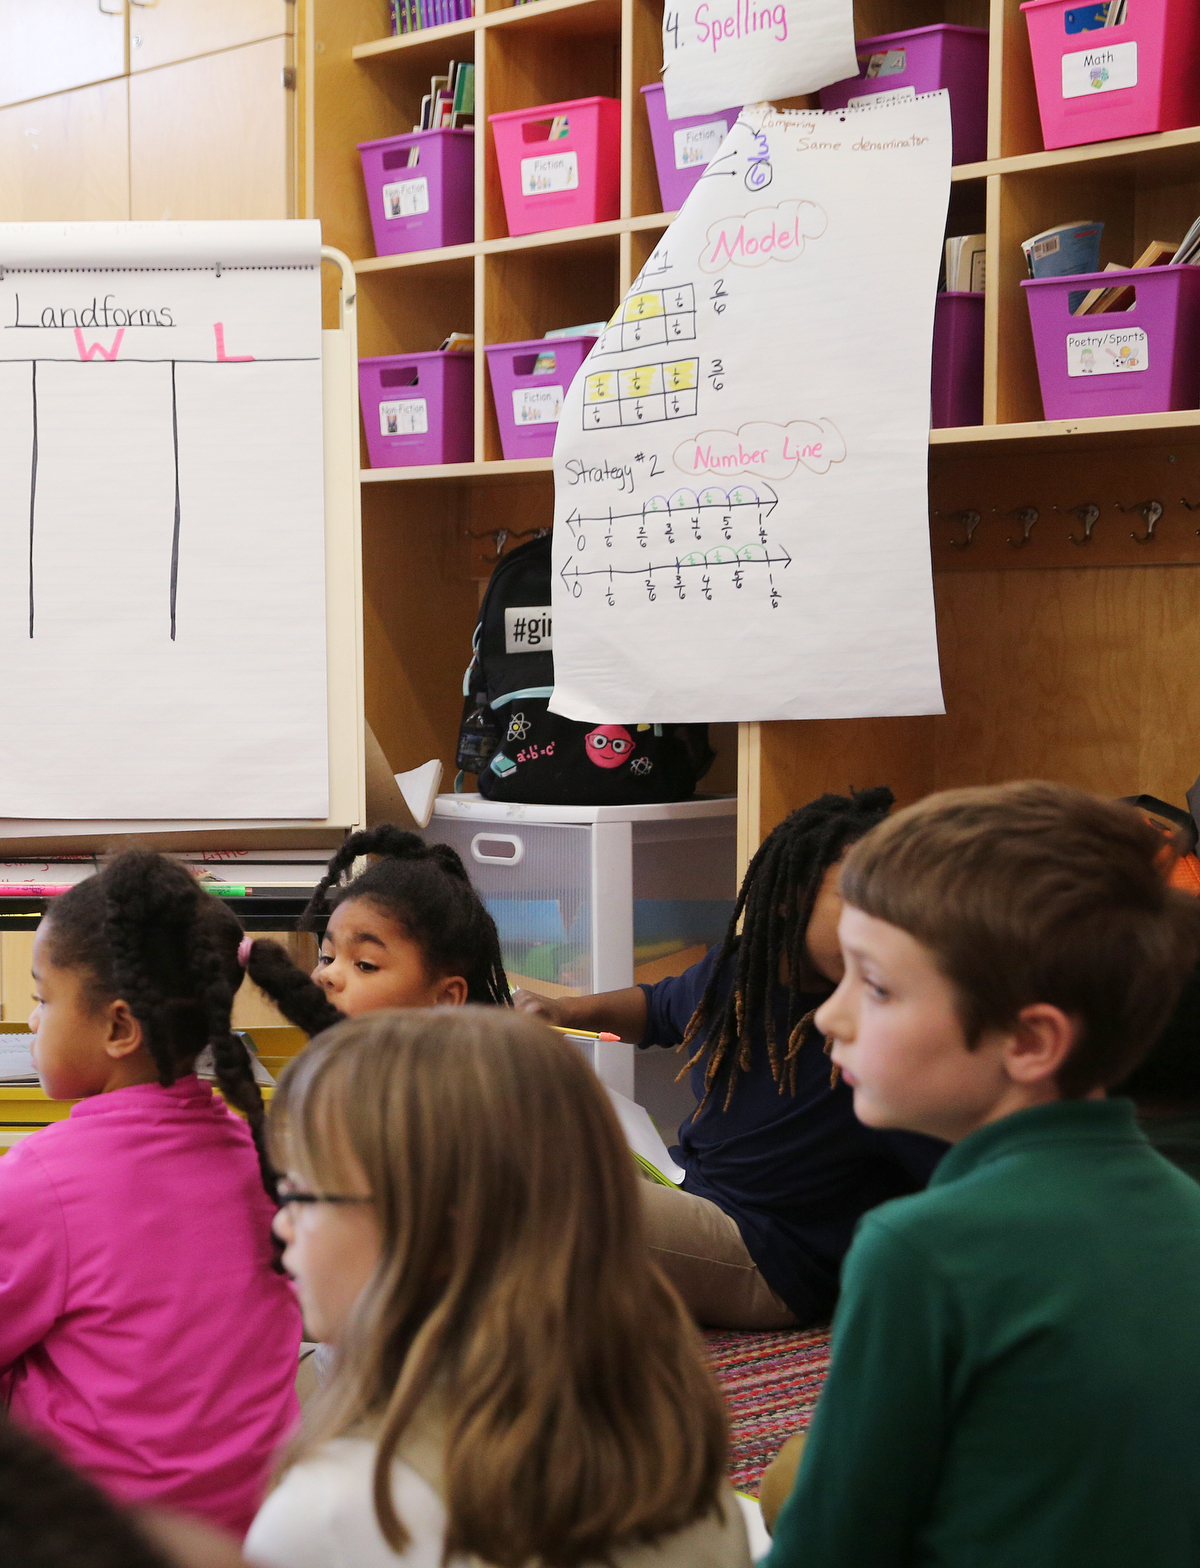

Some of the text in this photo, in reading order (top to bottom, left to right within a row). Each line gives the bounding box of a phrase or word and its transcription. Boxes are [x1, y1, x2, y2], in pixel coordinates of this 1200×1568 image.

[666, 0, 788, 52] 4. Spelling
[1083, 51, 1114, 67] Math
[761, 112, 816, 134] Comparing
[686, 130, 715, 143] Fiction
[796, 134, 930, 152] Same denominator
[534, 159, 564, 172] Fiction
[710, 215, 799, 263] Model
[15, 293, 173, 328] Landforms
[73, 326, 125, 361] W
[213, 321, 256, 362] L
[1068, 333, 1145, 347] Poetry/Sports
[523, 393, 551, 403] Fiction
[693, 436, 823, 470] Number Line
[565, 459, 634, 493] Strategy
[577, 534, 586, 551] 0
[572, 581, 583, 598] 0
